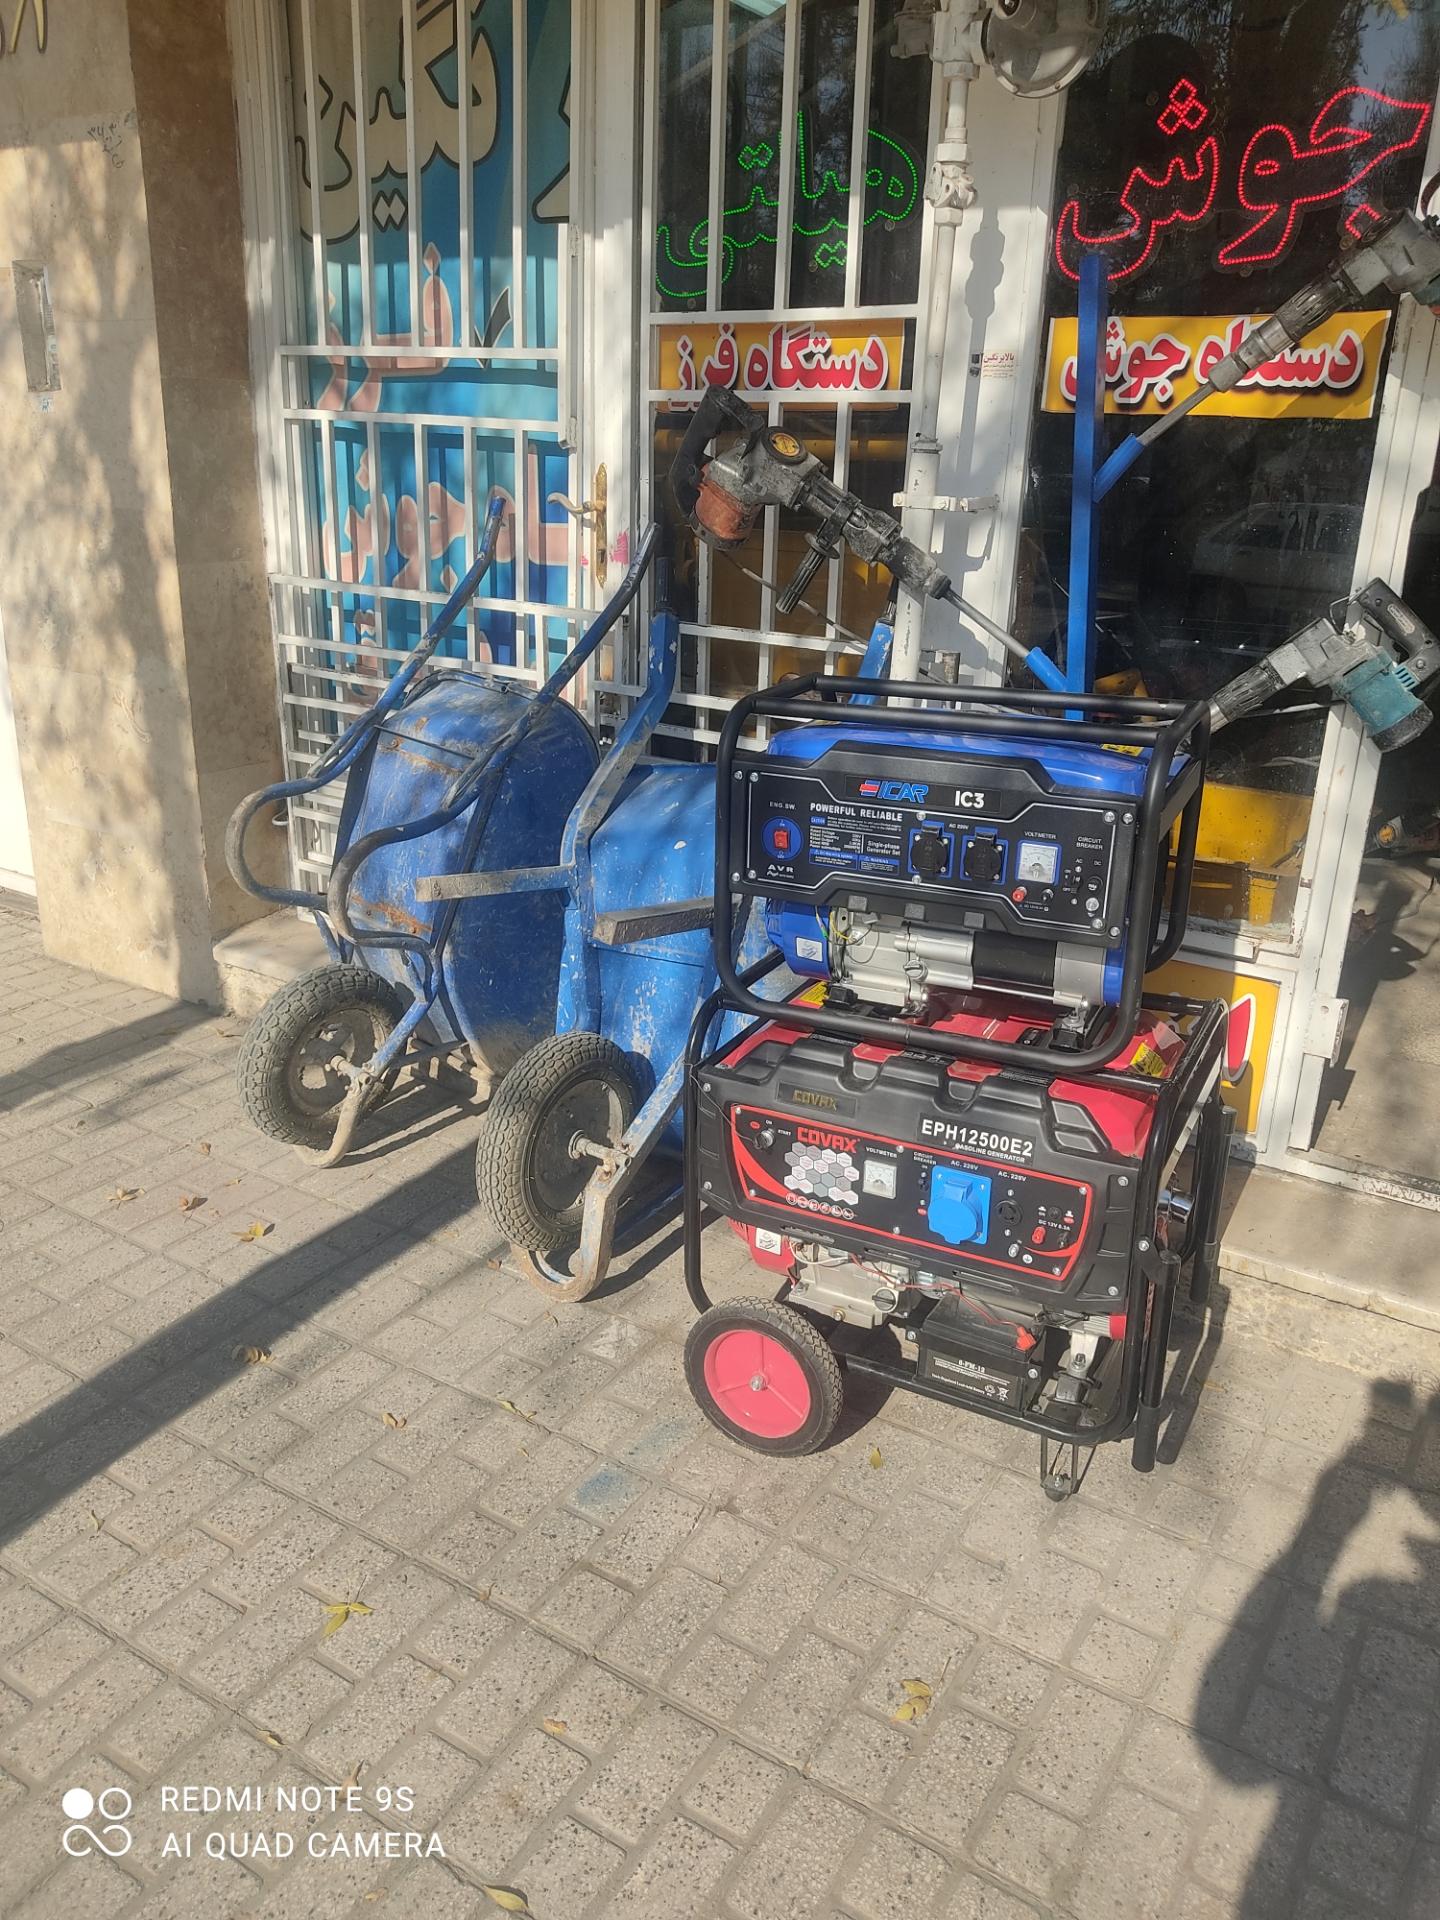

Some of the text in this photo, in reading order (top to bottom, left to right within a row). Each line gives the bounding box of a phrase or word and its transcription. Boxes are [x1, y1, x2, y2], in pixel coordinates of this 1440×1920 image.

[1055, 78, 1431, 280] جوش
[655, 110, 919, 297] هیلتی
[744, 322, 889, 390] دستگاه
[1060, 316, 1364, 405] دساه جوش
[954, 790, 985, 809] IC3
[809, 802, 903, 822] POWERFUL RELIABLE
[867, 840, 900, 850] Single-phase
[1024, 831, 1057, 839] VOLTMETER
[1077, 836, 1102, 844] CIRCUIT
[866, 846, 891, 855] Generator
[1076, 842, 1103, 850] BREAKER
[768, 864, 794, 873] AVR
[793, 1089, 837, 1111] COVAX
[797, 1126, 858, 1153] COVAX
[921, 1118, 1033, 1158] EPH12500E2
[865, 1146, 898, 1159] VOLTMETER
[954, 1143, 1026, 1164] GASOLINE GENERATOR
